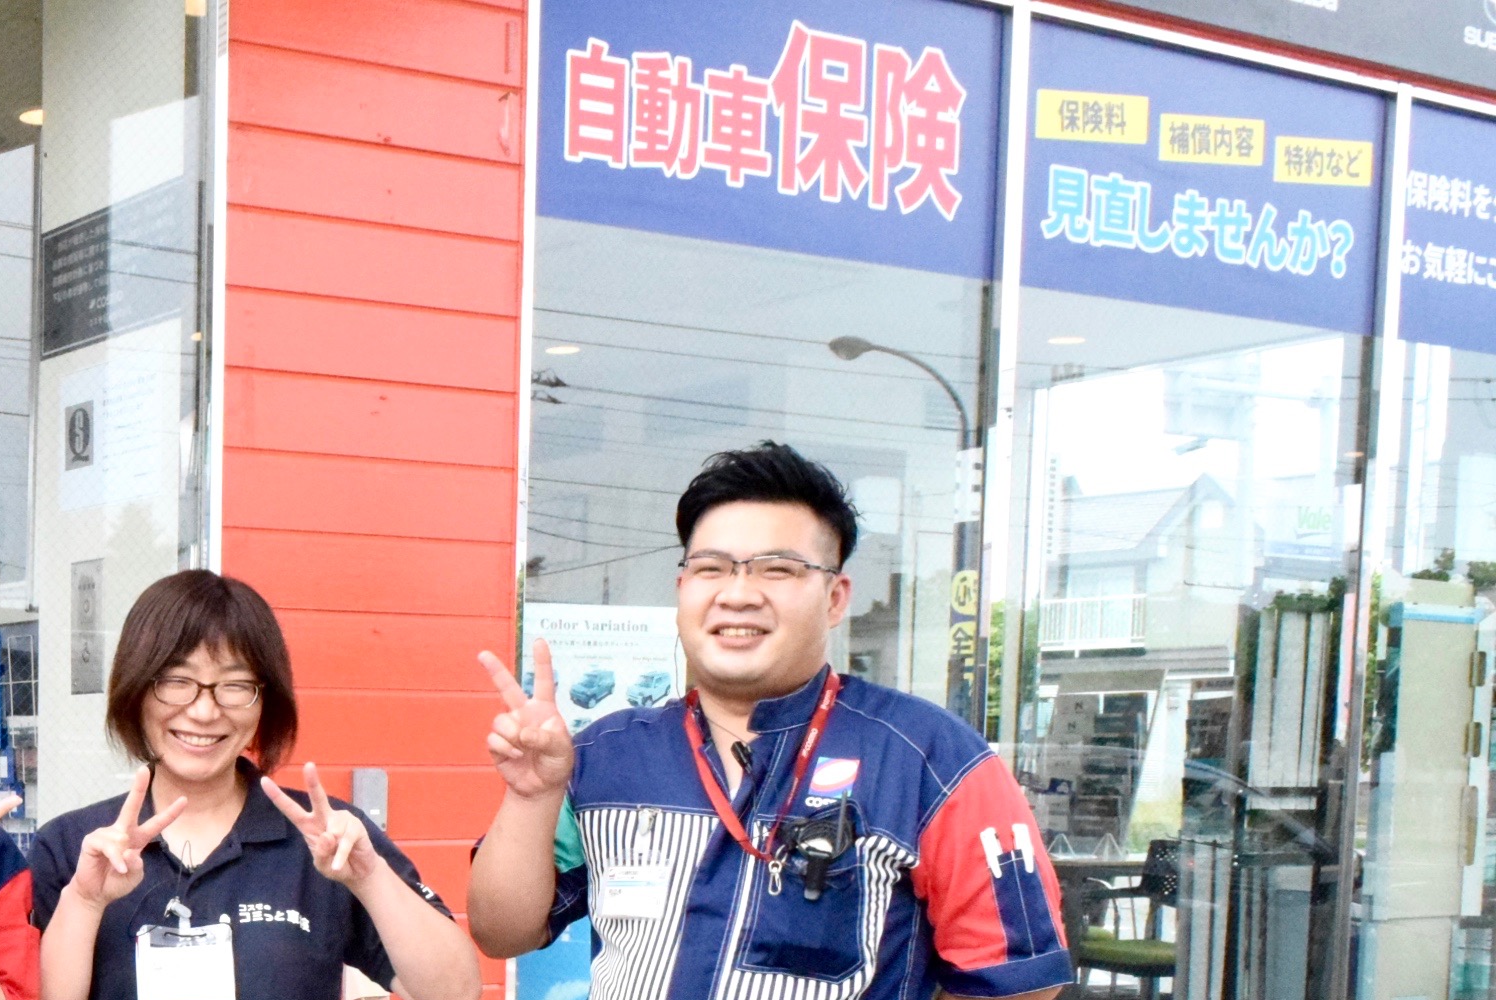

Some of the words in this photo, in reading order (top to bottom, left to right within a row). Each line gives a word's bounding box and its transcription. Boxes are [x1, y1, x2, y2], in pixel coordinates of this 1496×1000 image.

[564, 20, 966, 221] 自動車保険
[1059, 100, 1127, 134] 保険料
[1169, 121, 1255, 158] 補償内容
[1284, 144, 1363, 179] 特約など
[1406, 169, 1496, 223] 保険料を
[1041, 164, 1354, 279] 見直しませんか?
[540, 618, 579, 630] Color
[583, 620, 648, 632] Variation
